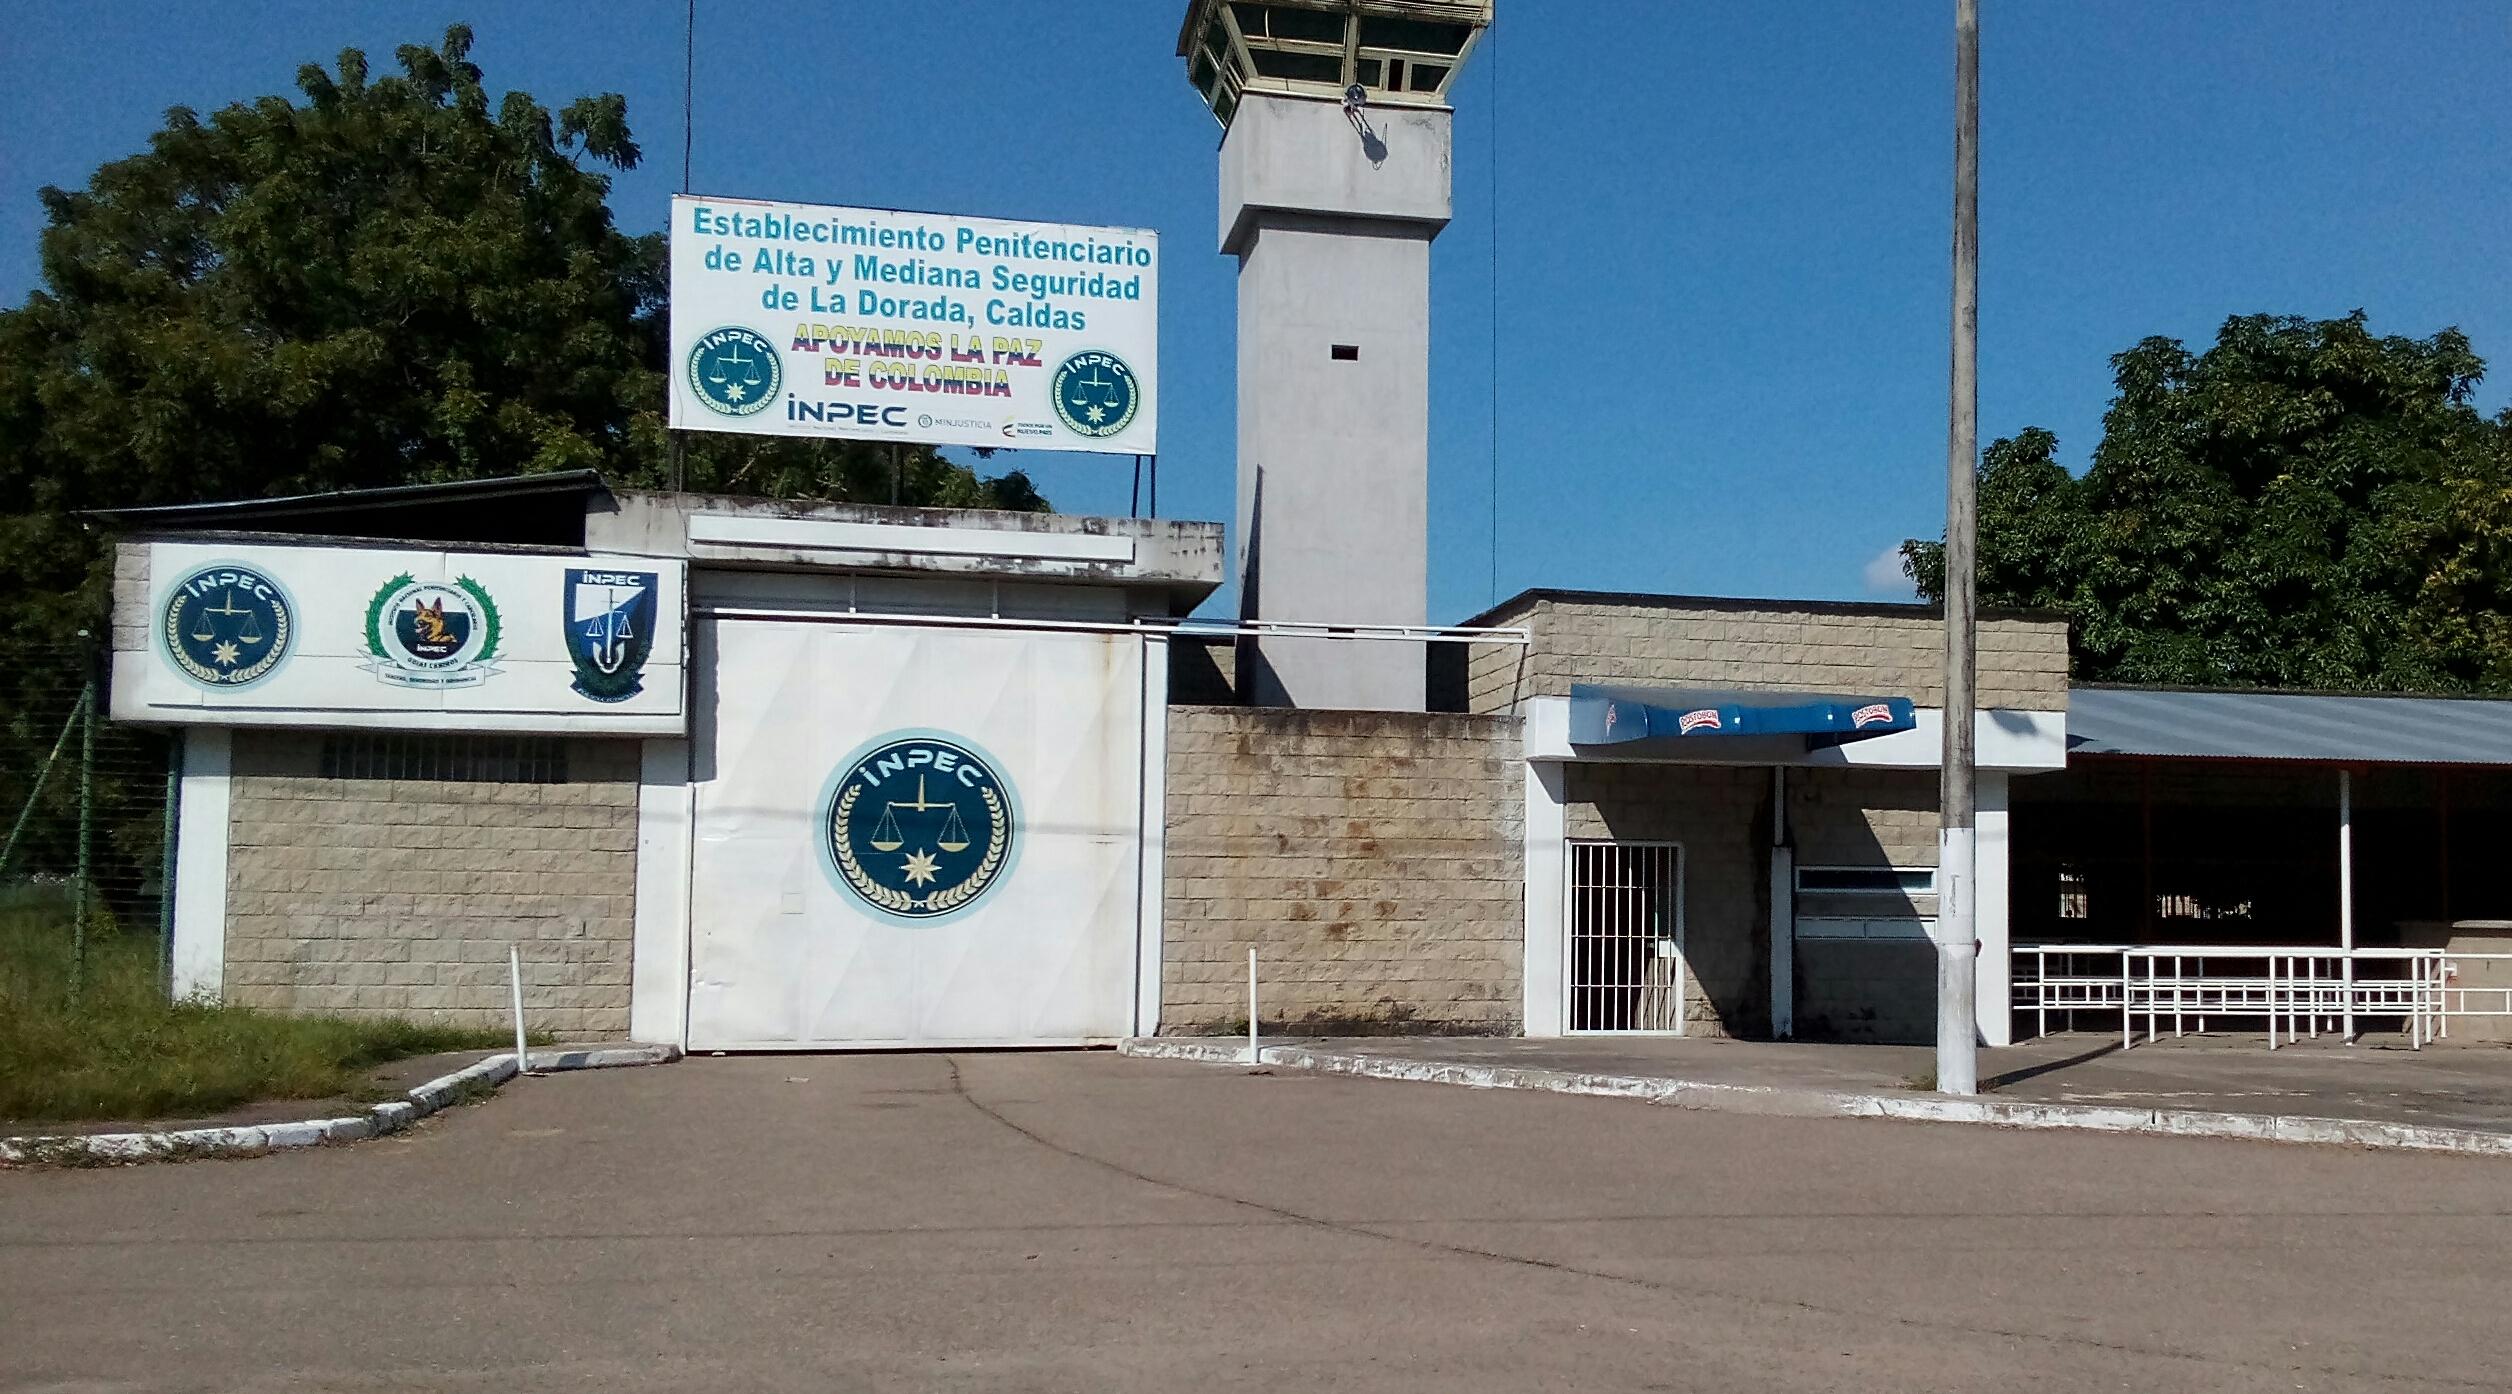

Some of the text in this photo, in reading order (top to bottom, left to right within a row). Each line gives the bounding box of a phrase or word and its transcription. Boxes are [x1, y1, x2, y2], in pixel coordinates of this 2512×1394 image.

[693, 207, 1152, 267] Establecimiento Penitenciario
[705, 244, 1140, 300] de Alta y Mediana Seguridad
[761, 284, 1086, 331] de La Dorada, Caldas
[703, 331, 767, 353] INPEC
[791, 323, 1043, 367] APOYAMOS LA PAZ
[825, 357, 1012, 398] DE COLOMBIA
[1065, 355, 1125, 376] INPEC
[935, 418, 992, 429] MINJUSTICIA
